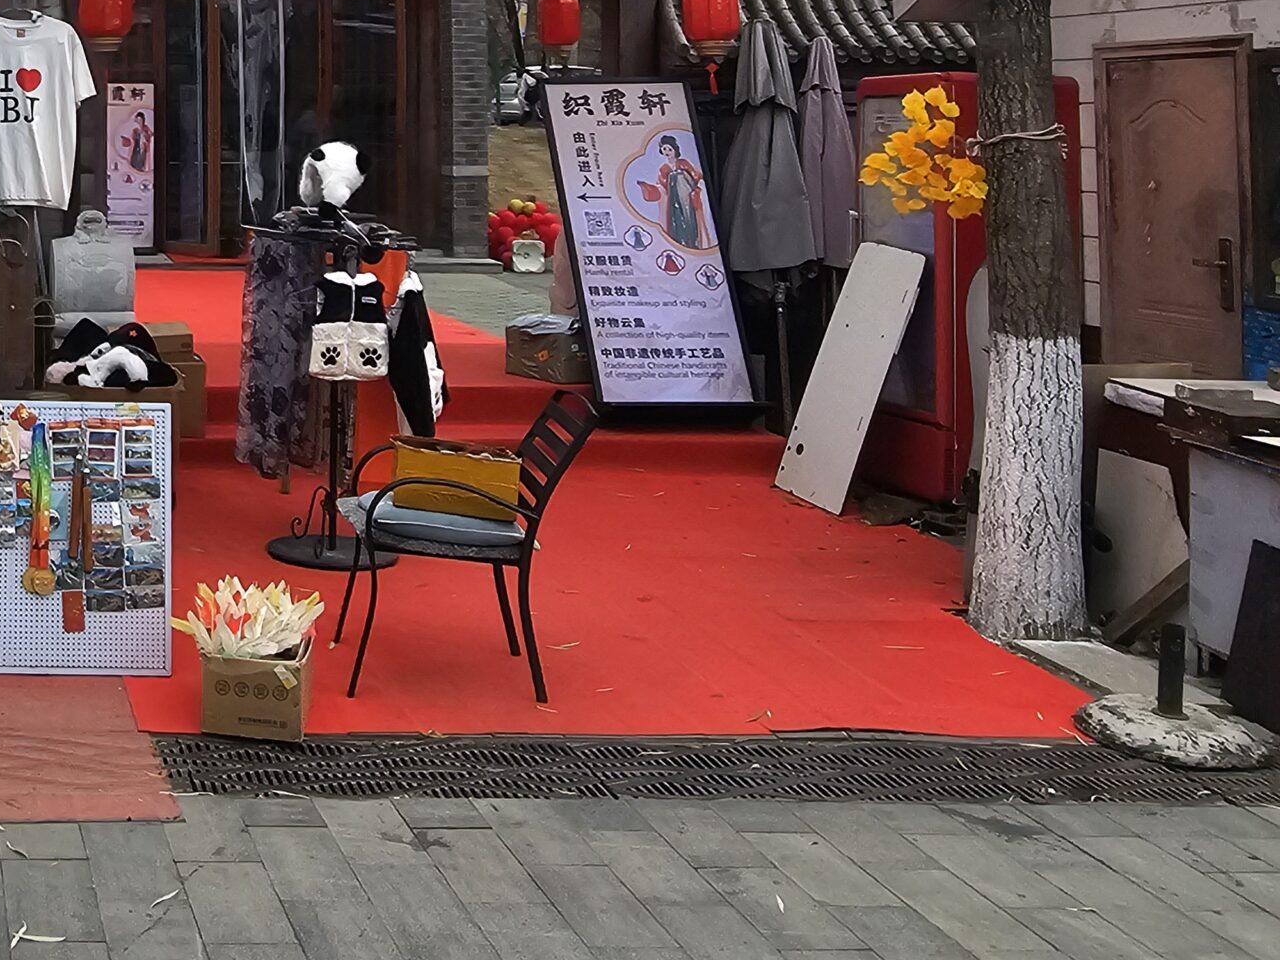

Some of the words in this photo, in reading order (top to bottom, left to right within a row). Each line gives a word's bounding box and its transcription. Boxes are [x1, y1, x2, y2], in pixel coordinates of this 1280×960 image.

[0, 69, 13, 93] I
[562, 88, 671, 117] 织霞轩
[0, 96, 40, 124] BJ
[573, 131, 596, 187] 由此进入
[583, 255, 633, 266] 汉服租赁
[588, 286, 639, 297] 精致妆造
[627, 300, 660, 308] makeup
[679, 300, 707, 308] styling
[594, 317, 646, 329] 好物云集
[600, 347, 725, 359] 中国非遗传统手工艺品
[603, 361, 646, 369] Traditional
[647, 361, 680, 370] Chinese
